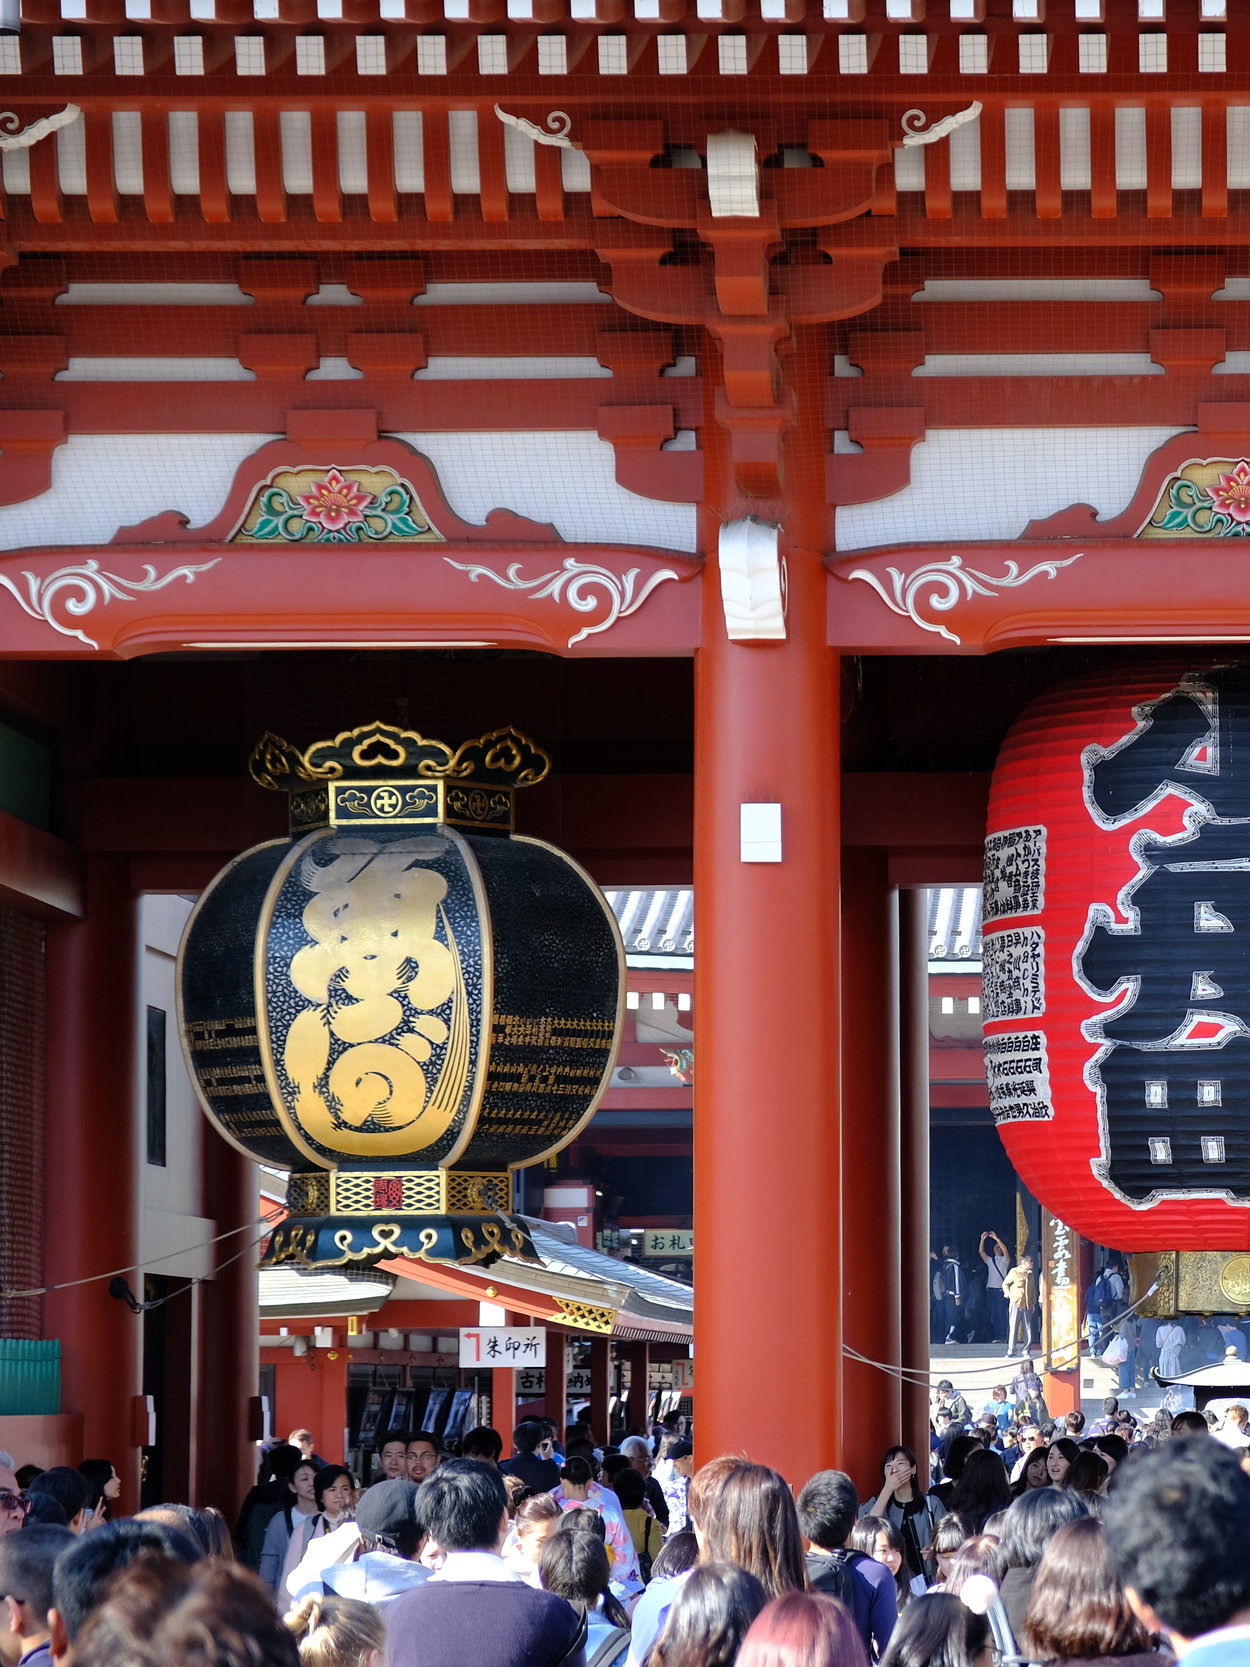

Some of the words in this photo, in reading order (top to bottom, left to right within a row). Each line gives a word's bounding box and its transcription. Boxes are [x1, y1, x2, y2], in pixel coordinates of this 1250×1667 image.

[651, 1234, 693, 1250] お札
[486, 1336, 540, 1359] 朱印所
